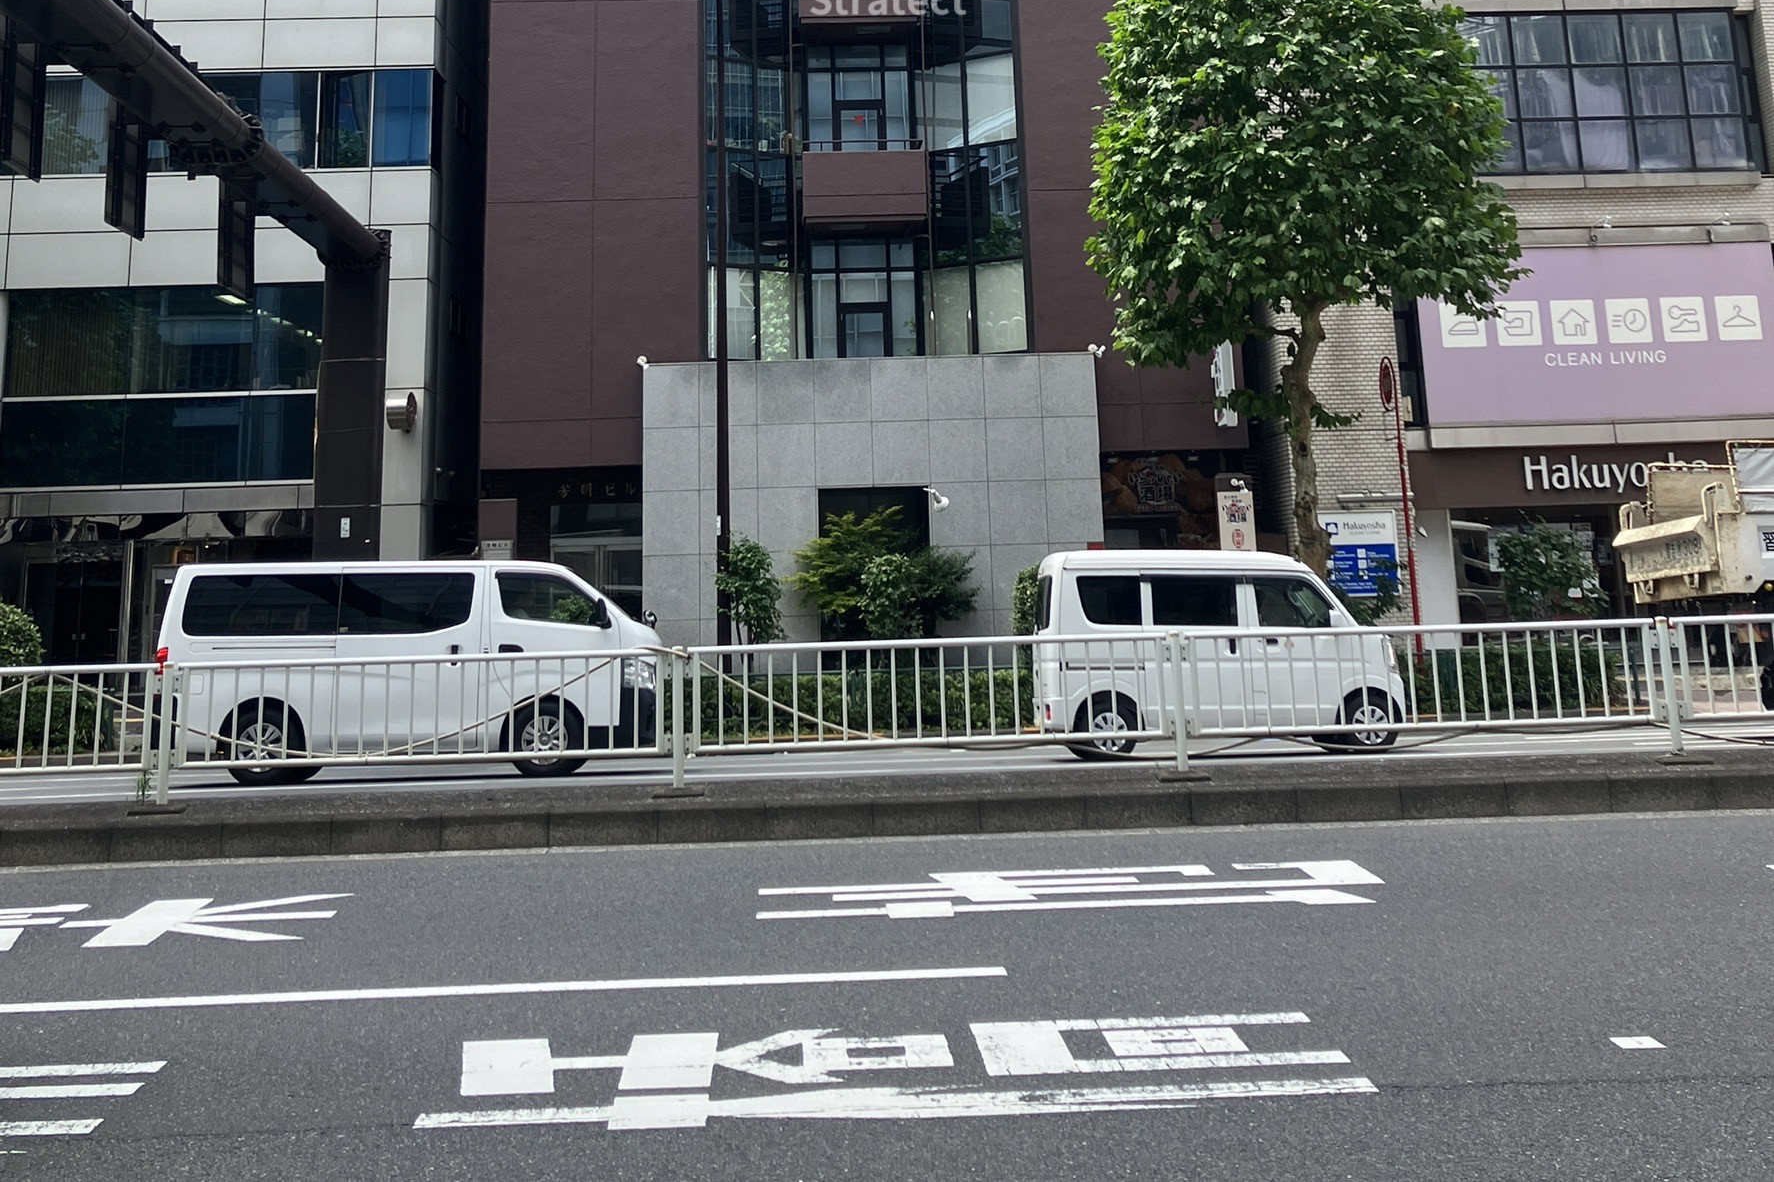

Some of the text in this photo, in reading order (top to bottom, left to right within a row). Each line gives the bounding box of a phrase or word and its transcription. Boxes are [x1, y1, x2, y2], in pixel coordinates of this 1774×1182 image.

[1544, 349, 1667, 367] CLEAN LIVING
[1523, 451, 1709, 494] Hakuyoh
[1342, 521, 1386, 530] Hakuyosha
